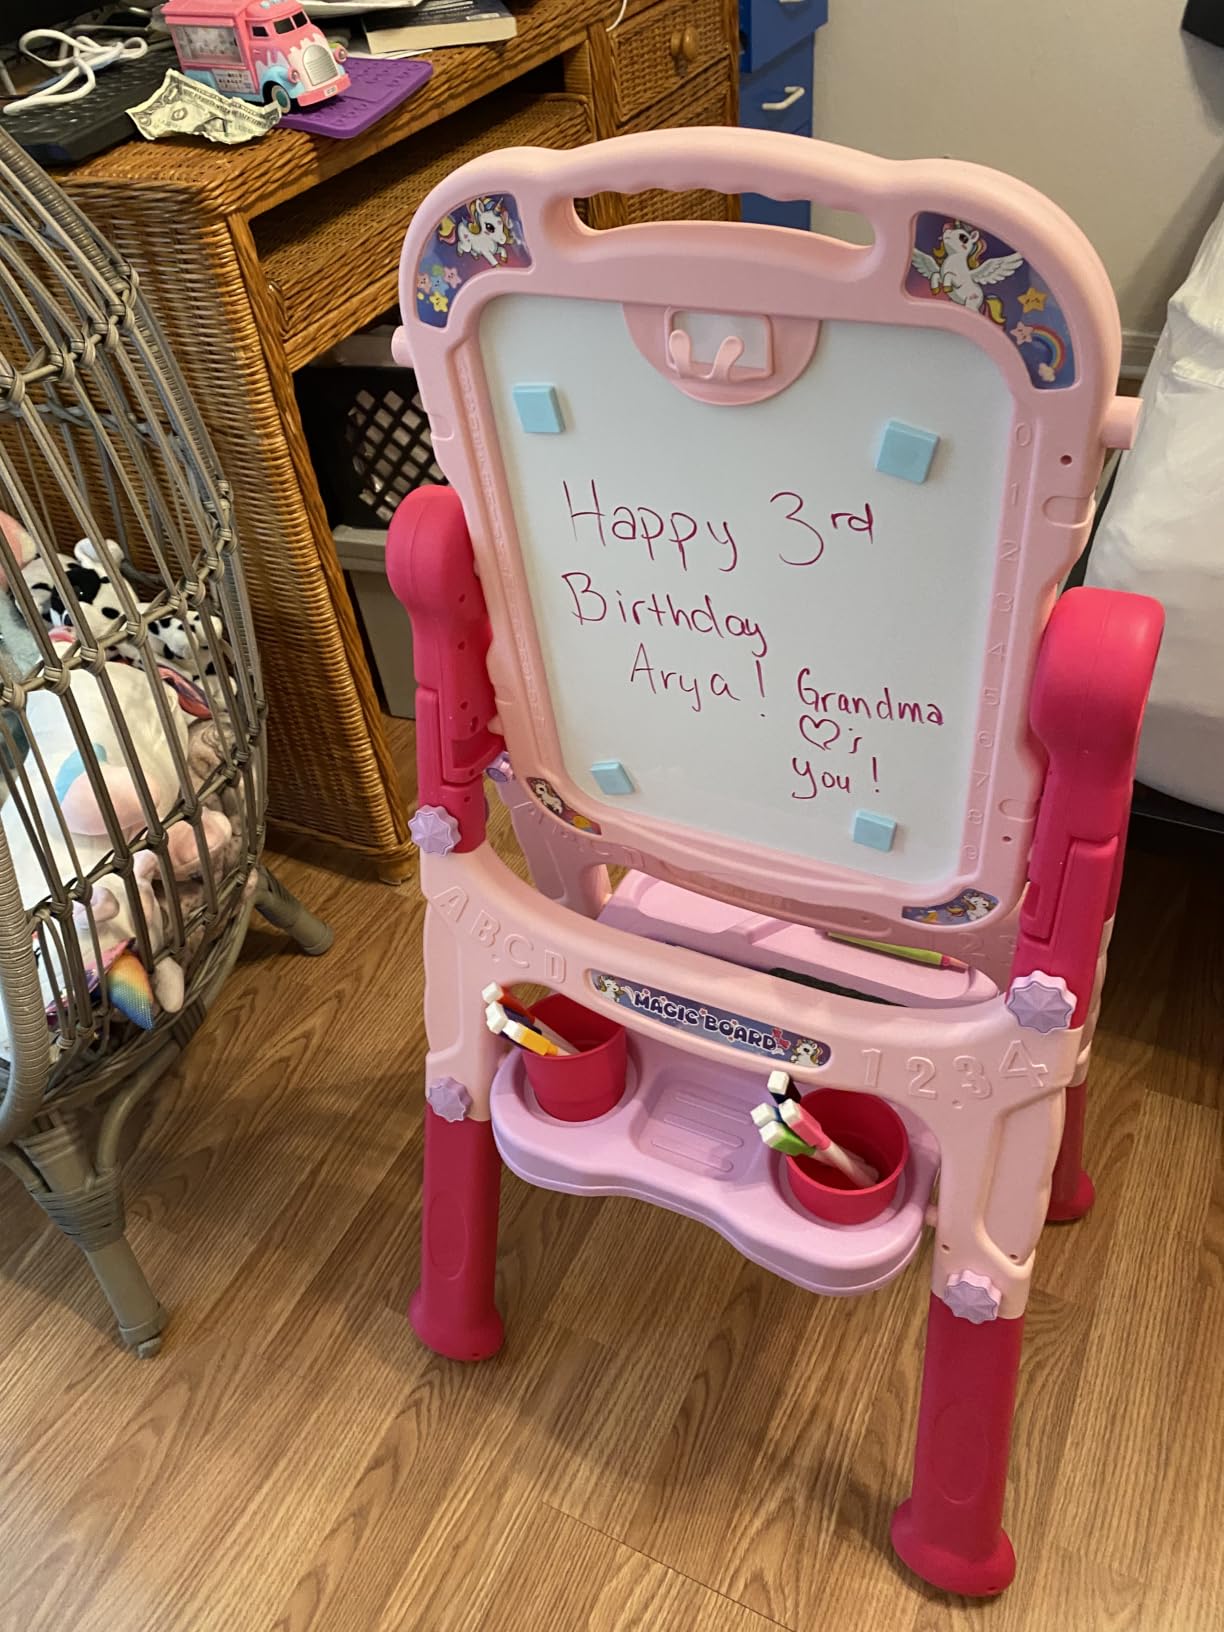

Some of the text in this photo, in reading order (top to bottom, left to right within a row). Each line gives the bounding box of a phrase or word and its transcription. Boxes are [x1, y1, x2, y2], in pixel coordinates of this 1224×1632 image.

[562, 479, 874, 572] Happy 3rd
[561, 571, 768, 658] Birthday
[630, 642, 767, 718] Arya!
[797, 667, 945, 727] Grandma
[633, 991, 778, 1052] MAGIC BOARD
